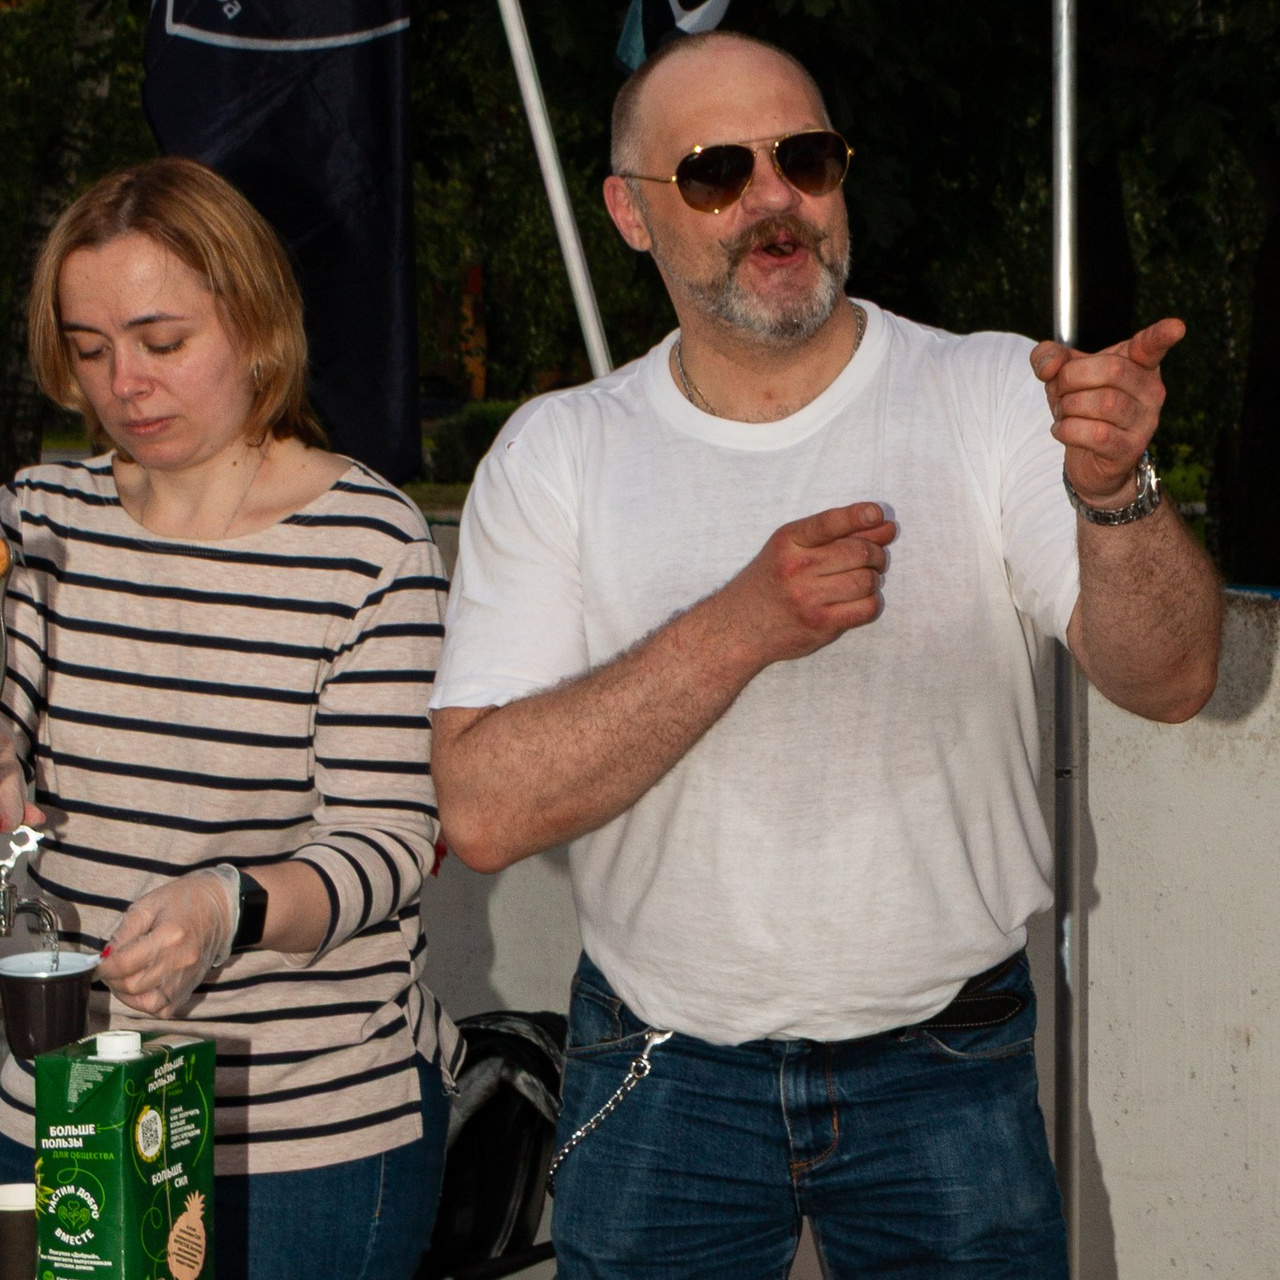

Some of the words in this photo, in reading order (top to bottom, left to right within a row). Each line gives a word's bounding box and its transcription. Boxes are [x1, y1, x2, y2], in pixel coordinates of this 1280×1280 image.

[49, 1124, 96, 1137] БОЛЬШЕ
[41, 1137, 83, 1149] ПОЛЬЗЫ
[70, 1151, 115, 1160] ОБЩЕСТВА
[48, 1185, 75, 1214] РАСТИМ
[76, 1187, 100, 1220] ДОБРО
[54, 1227, 95, 1246] ВМЕСТЕ
